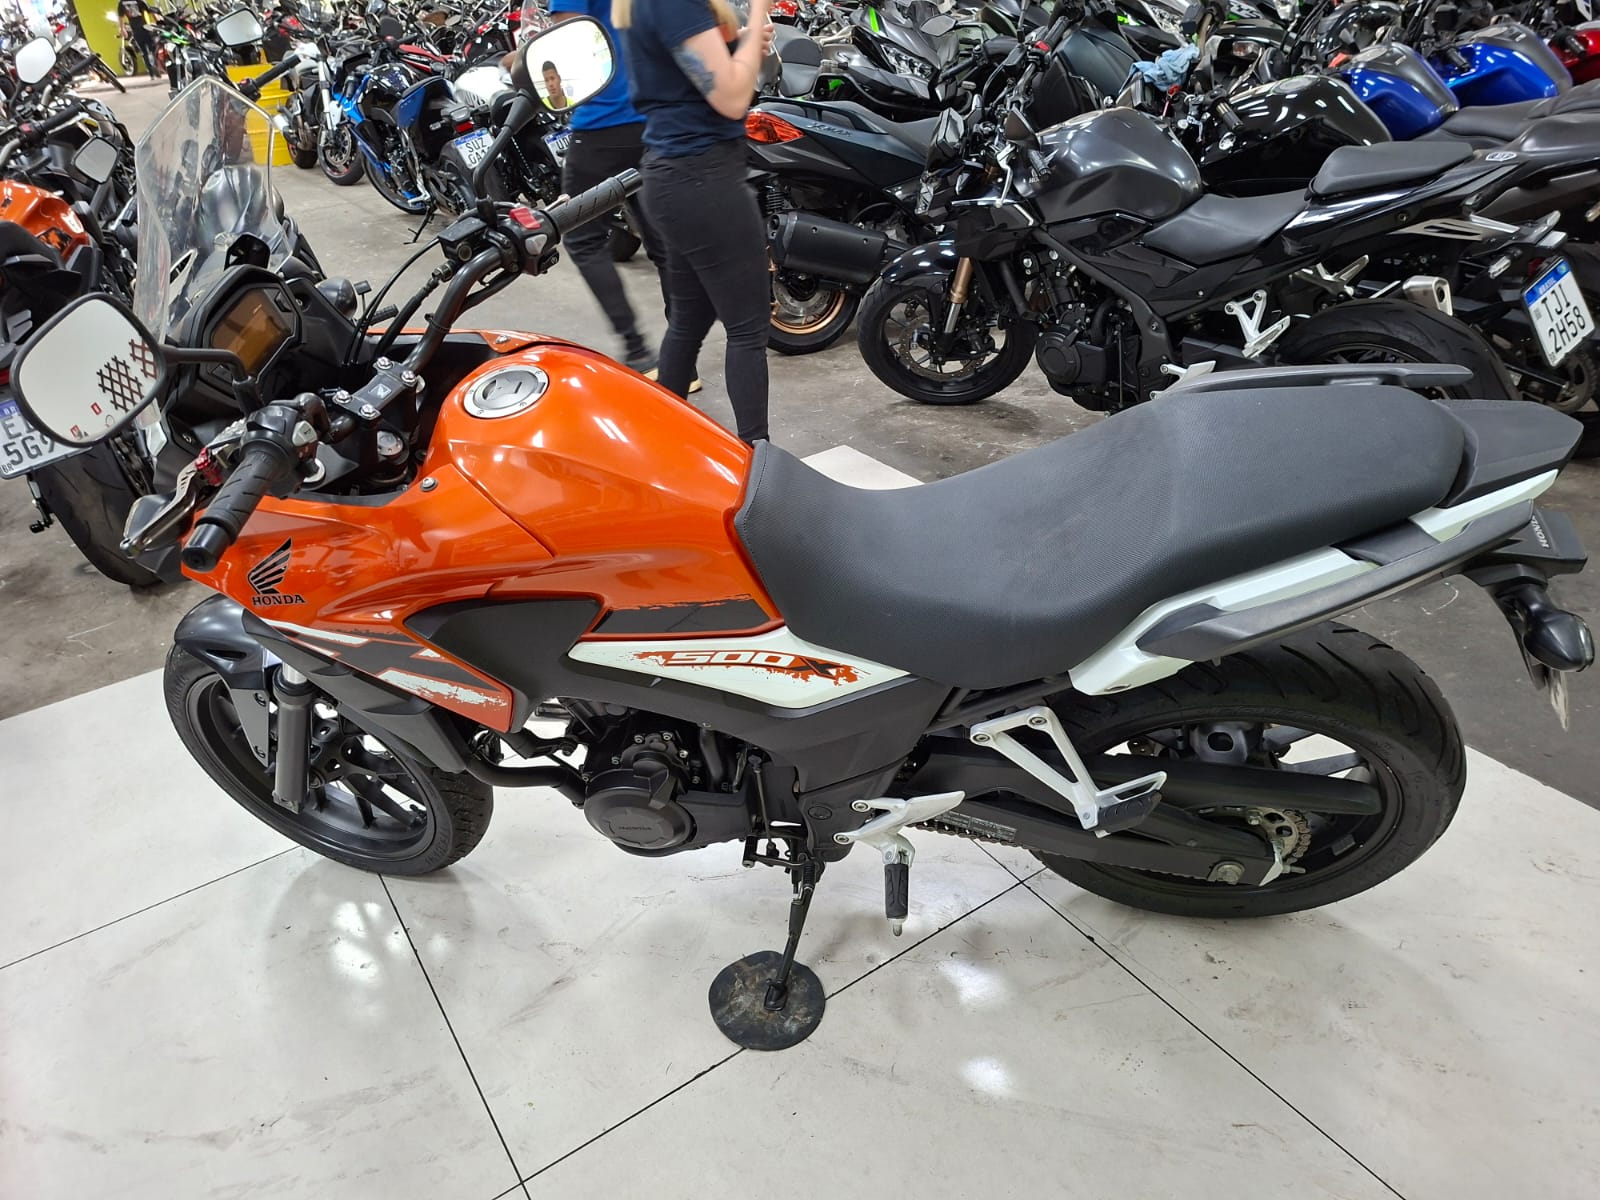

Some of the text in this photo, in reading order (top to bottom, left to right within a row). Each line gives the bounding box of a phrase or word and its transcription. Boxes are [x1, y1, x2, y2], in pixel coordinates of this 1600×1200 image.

[465, 137, 488, 153] SUZ
[1541, 284, 1571, 323] TJI
[1548, 305, 1586, 354] 2H58
[3, 433, 55, 466] 5G9
[251, 594, 306, 606] HONDA
[666, 650, 840, 680] 500X
